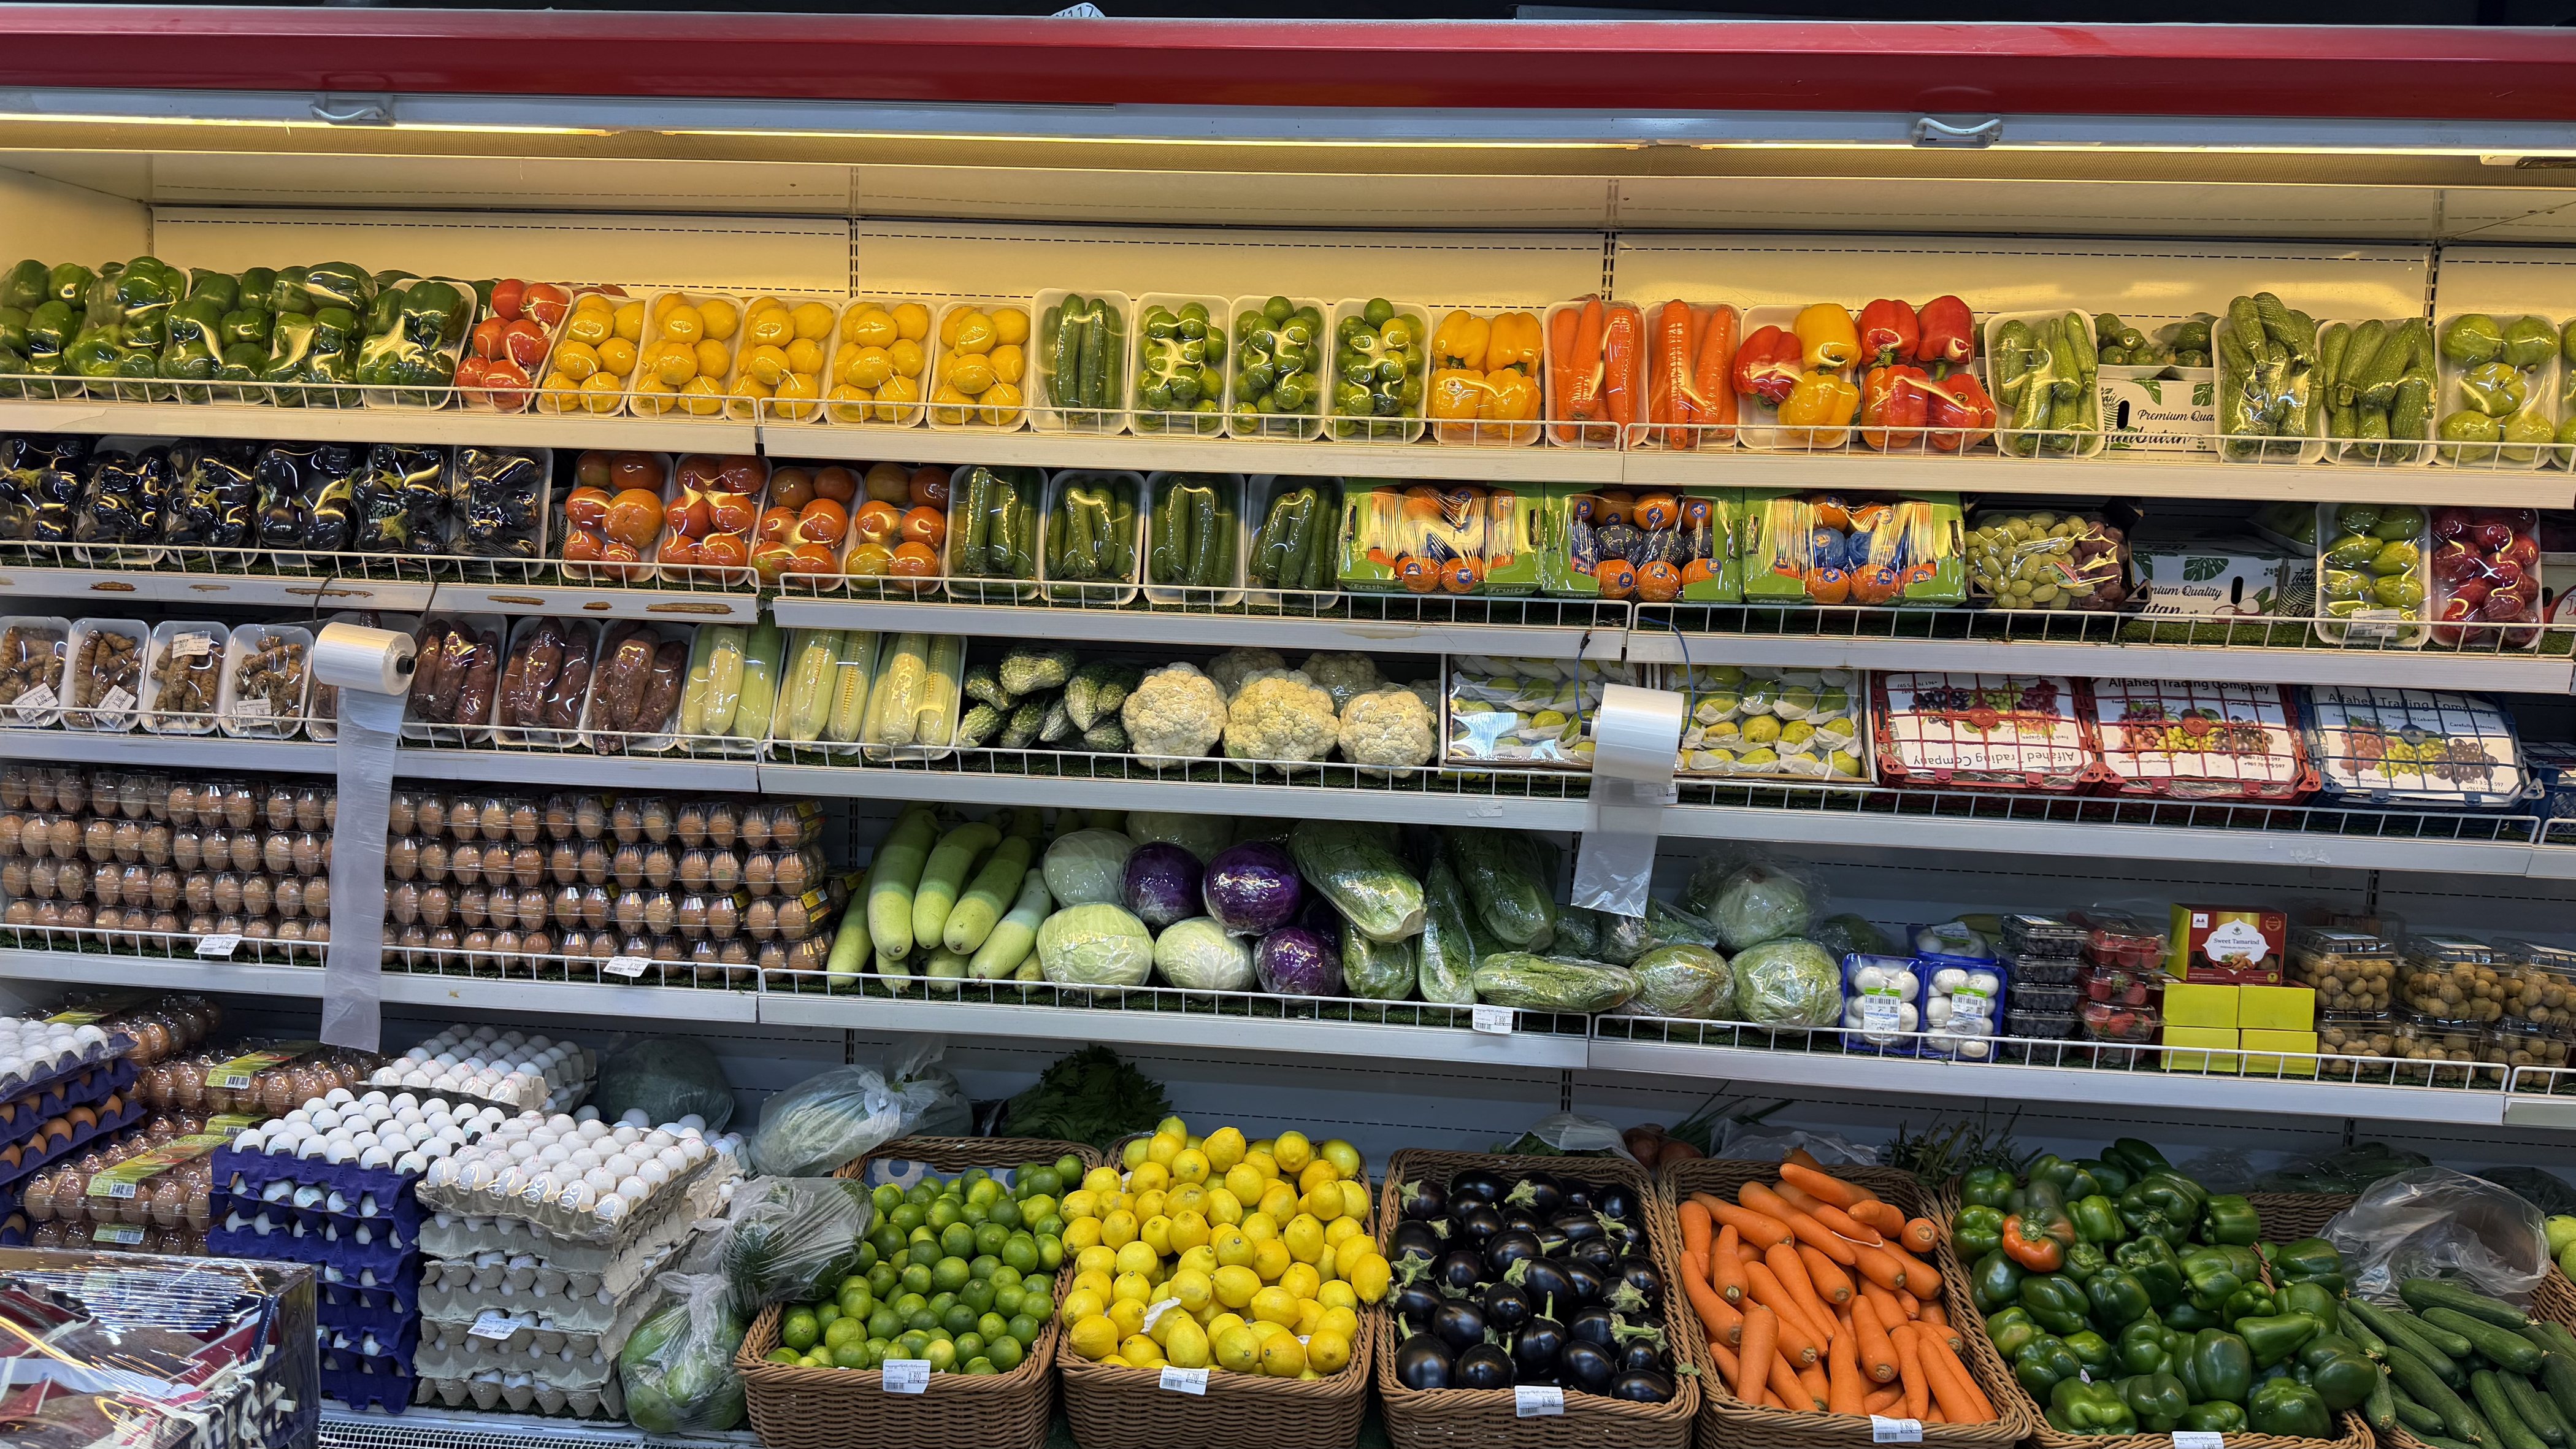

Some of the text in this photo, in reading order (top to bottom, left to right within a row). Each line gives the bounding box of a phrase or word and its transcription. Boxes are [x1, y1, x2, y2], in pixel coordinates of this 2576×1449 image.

[2137, 409, 2215, 422] Premium Qua
[1600, 531, 1616, 548] CORE
[2182, 585, 2223, 601] Quality
[1913, 755, 1972, 766] Company
